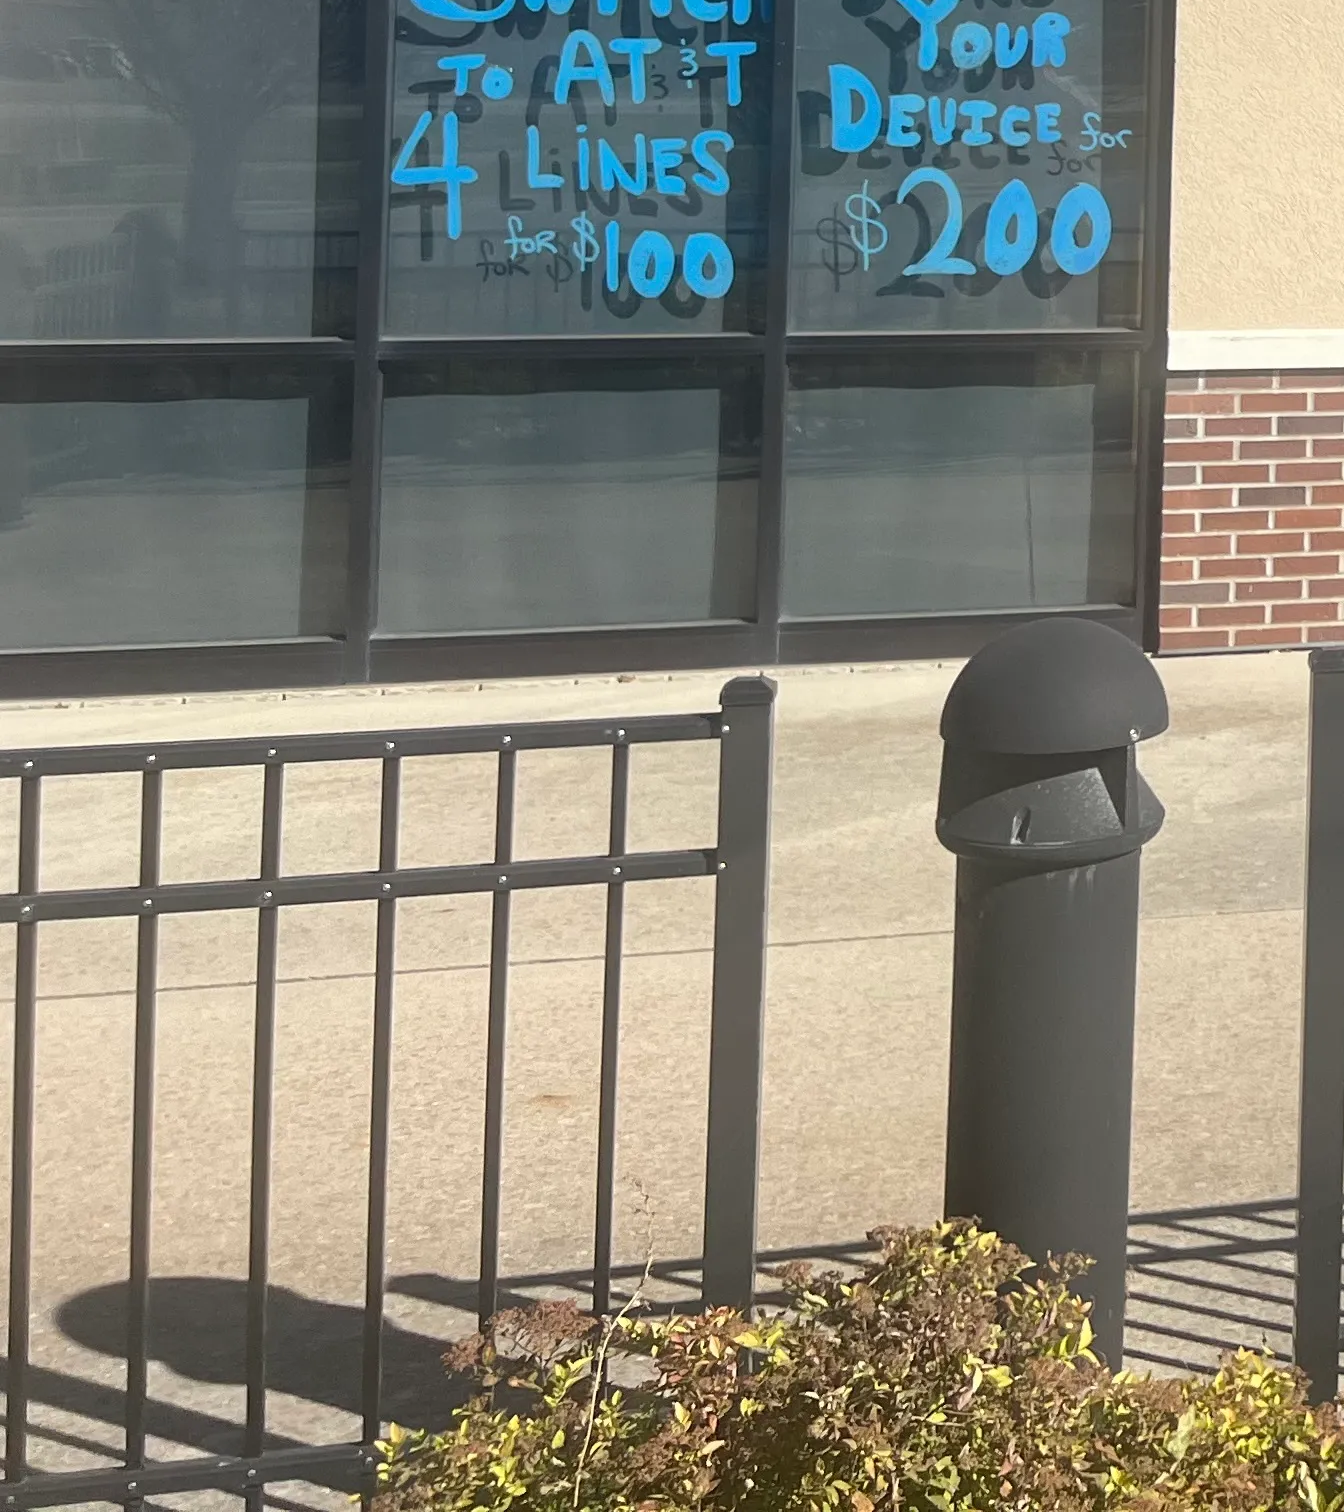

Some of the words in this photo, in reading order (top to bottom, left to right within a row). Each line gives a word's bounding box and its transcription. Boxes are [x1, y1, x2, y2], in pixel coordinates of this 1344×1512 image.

[437, 54, 514, 100] TO
[827, 63, 1063, 153] DEVICE
[1078, 111, 1134, 152] for
[390, 110, 479, 240] 4
[569, 210, 735, 299] $100
[844, 166, 1113, 276] $200
